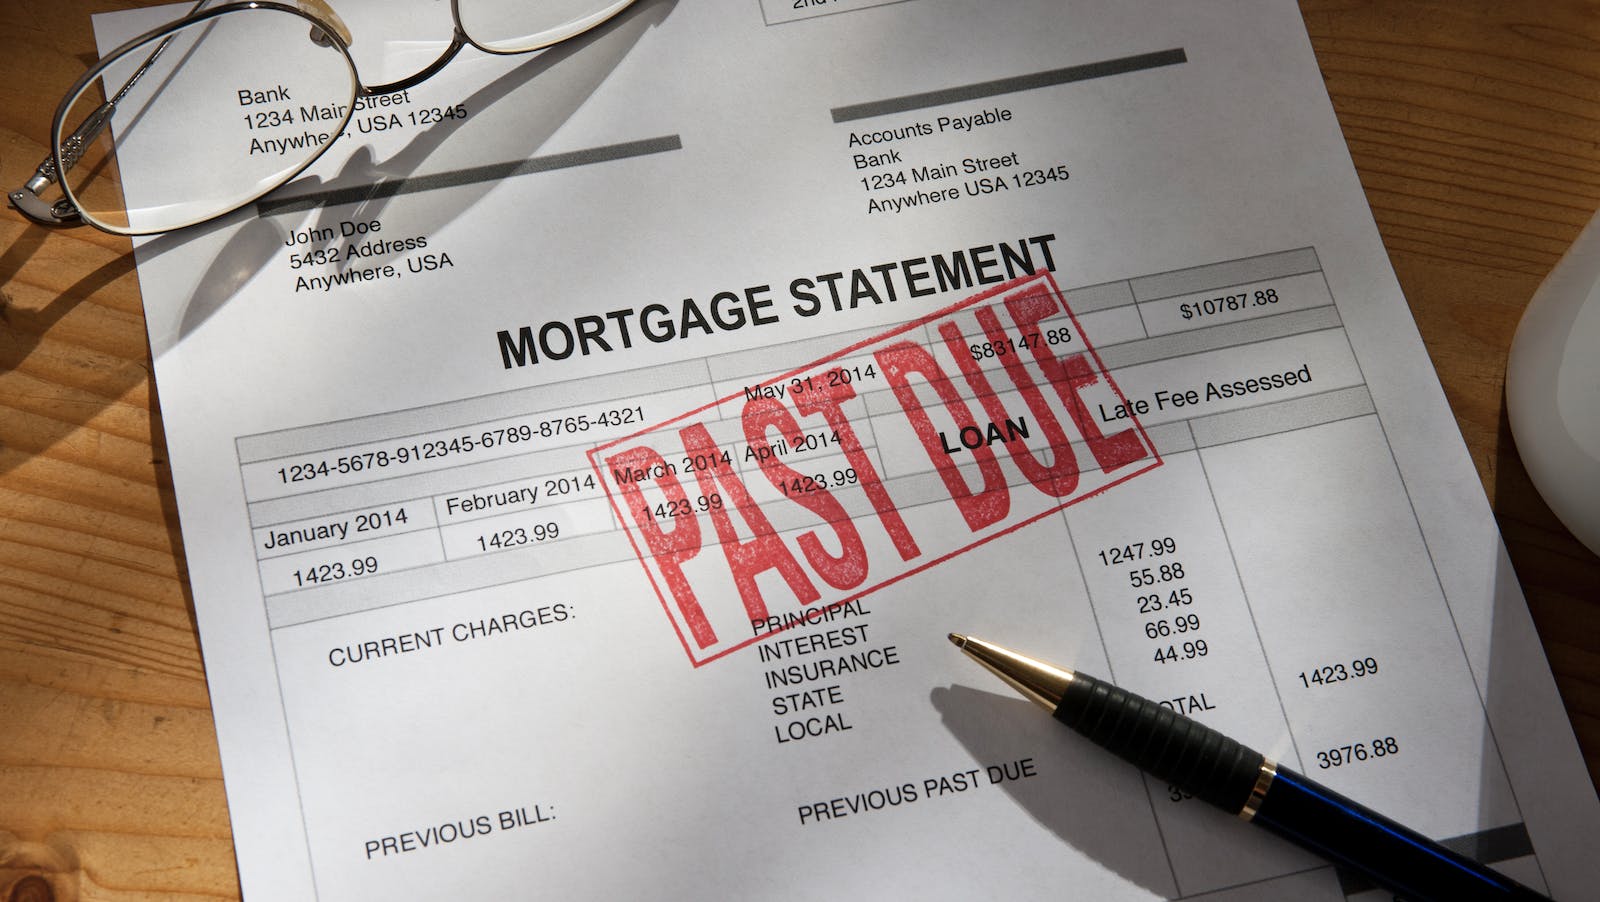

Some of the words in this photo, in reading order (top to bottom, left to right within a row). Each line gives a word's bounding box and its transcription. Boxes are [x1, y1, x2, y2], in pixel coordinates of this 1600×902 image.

[238, 85, 291, 106] Bank
[244, 109, 294, 129] 1234
[354, 90, 411, 111] Street
[250, 131, 351, 155] Anywhe,
[358, 114, 403, 133] USA
[409, 104, 467, 125] 12345
[849, 123, 933, 148] Accounts
[937, 108, 1012, 132] Payable
[853, 149, 902, 169] Bank
[861, 171, 907, 191] 1234
[912, 164, 958, 183] Main
[962, 152, 1019, 173] Street
[869, 188, 959, 214] Anywhere
[964, 177, 1008, 196] USA
[1013, 166, 1069, 187] 12345
[285, 228, 334, 246] John
[341, 218, 382, 237] Doe
[291, 248, 341, 269] 5432
[346, 236, 427, 260] Address
[296, 266, 400, 292] Anywhere,
[408, 253, 454, 273] USA
[497, 285, 779, 370] MORTGAGE
[790, 234, 1057, 317] STATEMENT
[1180, 289, 1279, 320] $10787.88
[970, 327, 1071, 361] $83147.88
[744, 385, 785, 402] May
[791, 376, 824, 395] 31,
[830, 365, 877, 388] 2014
[1099, 399, 1149, 422] Late
[1155, 391, 1199, 410] Fee
[1206, 364, 1312, 404] Assessed
[278, 406, 645, 484] 1234-5678-912345-6789-8765-4321
[744, 440, 788, 462] April
[795, 430, 842, 453] 2014
[939, 416, 1030, 455] LOAN
[606, 367, 921, 650] PAST
[874, 284, 1148, 532] DUE
[614, 461, 677, 486] March
[682, 451, 732, 473] 2014
[779, 468, 857, 497] 1423.99
[447, 484, 538, 515] February
[545, 474, 596, 497] 2014
[642, 494, 723, 522] 1423.99
[264, 519, 348, 551] January
[356, 508, 408, 533] 2014
[477, 522, 559, 552] 1423.99
[1099, 537, 1175, 566] 1247.99
[293, 556, 378, 587] 1423.99
[1130, 562, 1184, 587] 55.88
[752, 599, 871, 637] PRINCIPAL
[1137, 588, 1192, 614] 23.45
[329, 628, 444, 666] CURRENT
[452, 604, 575, 641] CHARGES:
[758, 624, 870, 663] INTEREST
[1145, 614, 1199, 639] 66.99
[765, 647, 900, 689] INSURANCE
[1154, 640, 1208, 664] 44.99
[1299, 657, 1377, 688] 1423.99
[773, 685, 844, 715] STATE
[775, 713, 852, 743] LOCAL
[1317, 737, 1398, 769] 3976.88
[798, 784, 918, 825] PREVIOUS
[924, 770, 979, 798] PAST
[986, 758, 1037, 784] DUE
[365, 816, 492, 860] PREVIOUS
[498, 805, 555, 830] BILL:
